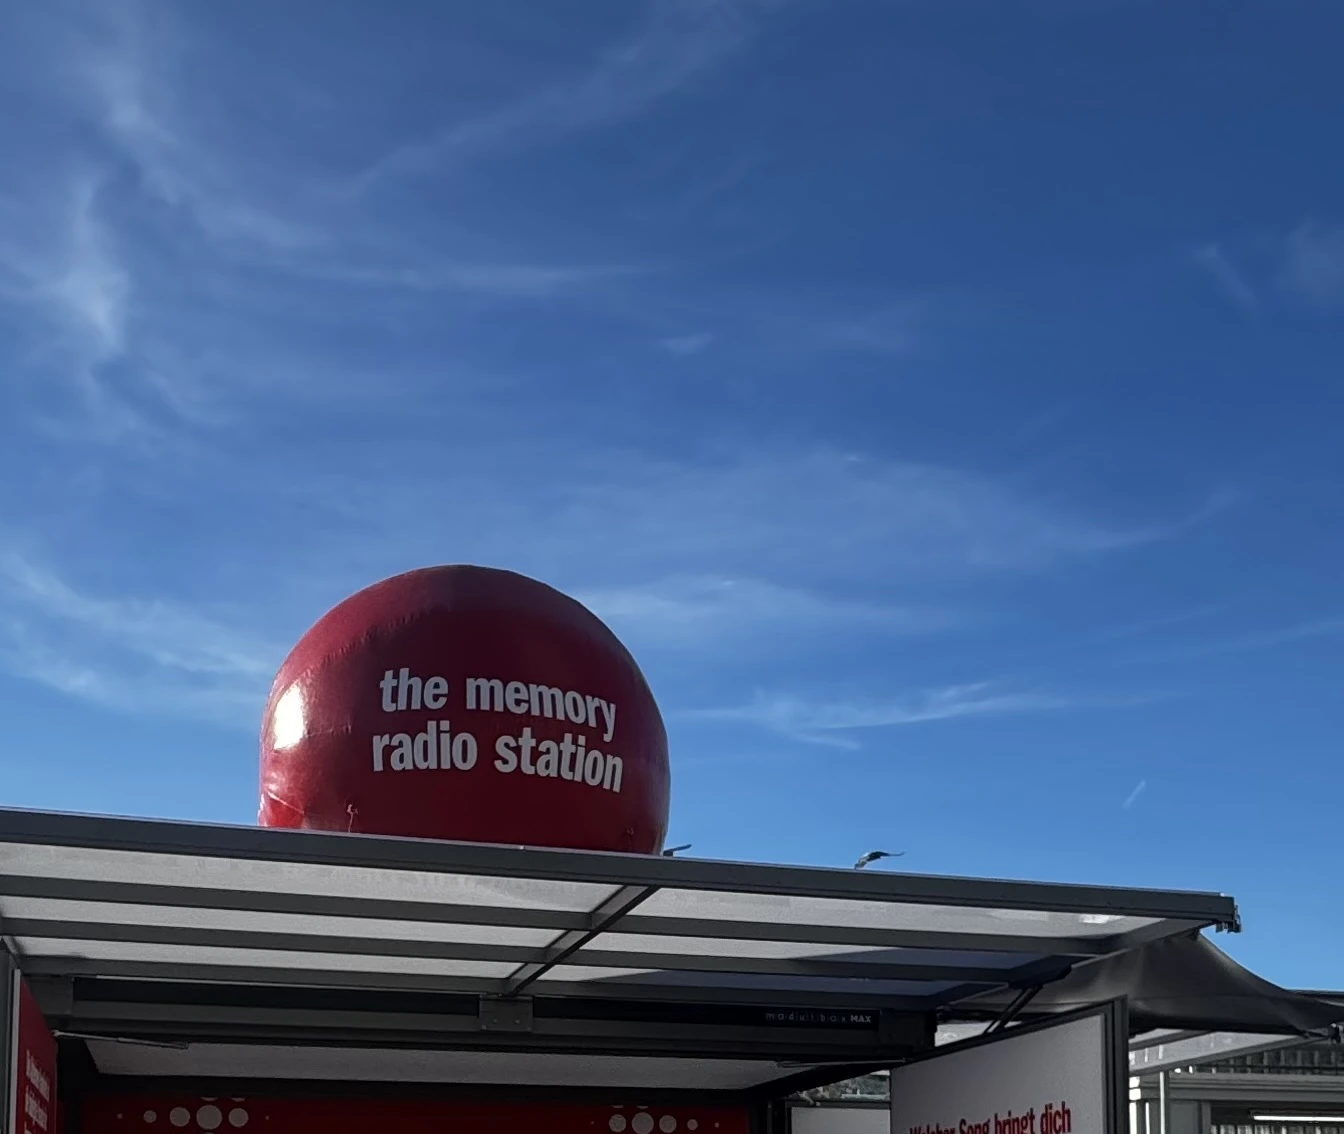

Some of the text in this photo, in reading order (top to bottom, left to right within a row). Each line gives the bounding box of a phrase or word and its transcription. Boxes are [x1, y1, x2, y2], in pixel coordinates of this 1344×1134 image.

[379, 667, 617, 742] the memory
[372, 720, 624, 793] radio station
[850, 1014, 872, 1023] MAX
